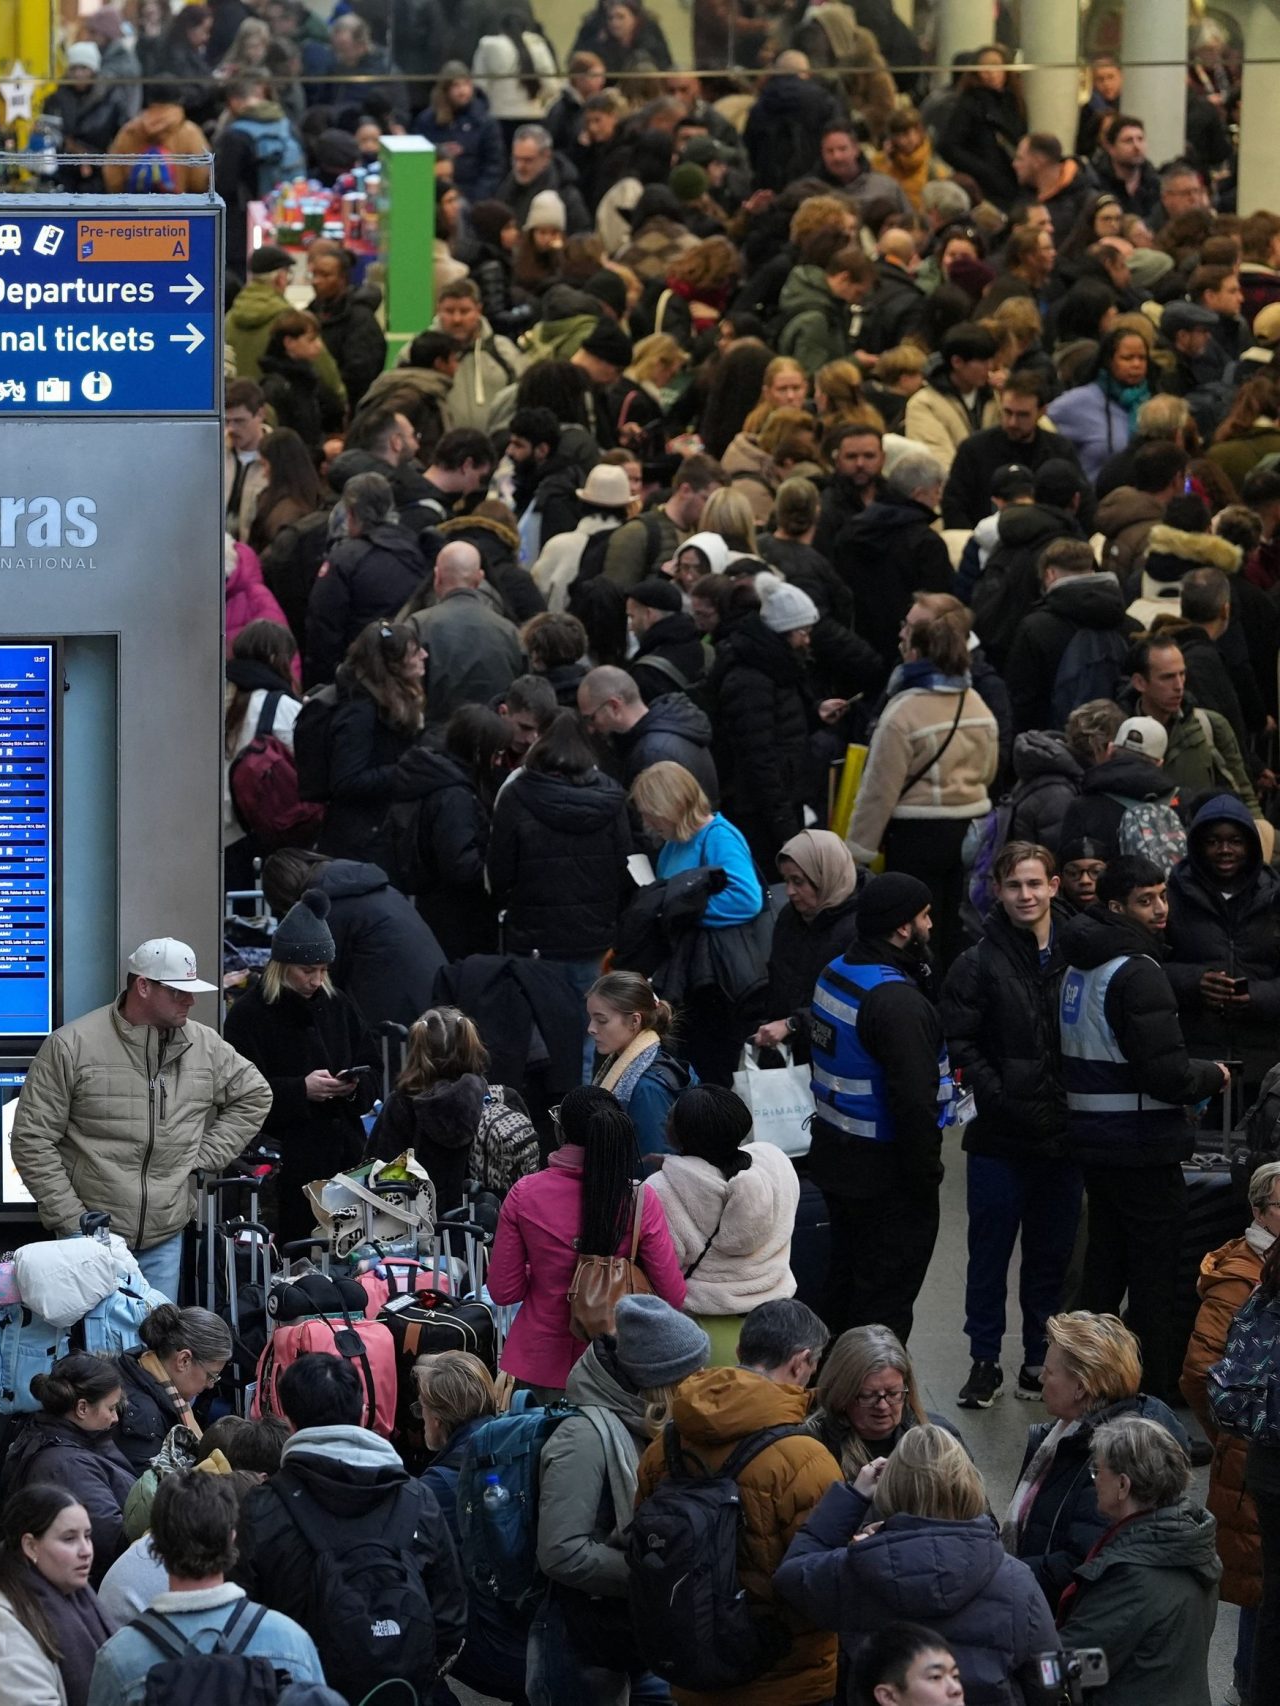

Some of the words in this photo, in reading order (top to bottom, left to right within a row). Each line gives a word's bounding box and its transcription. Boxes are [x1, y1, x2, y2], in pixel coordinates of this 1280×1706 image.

[81, 225, 186, 240] Pre-registration
[172, 240, 186, 257] A
[55, 325, 154, 351] tickets
[754, 1105, 810, 1117] PRIMARK
